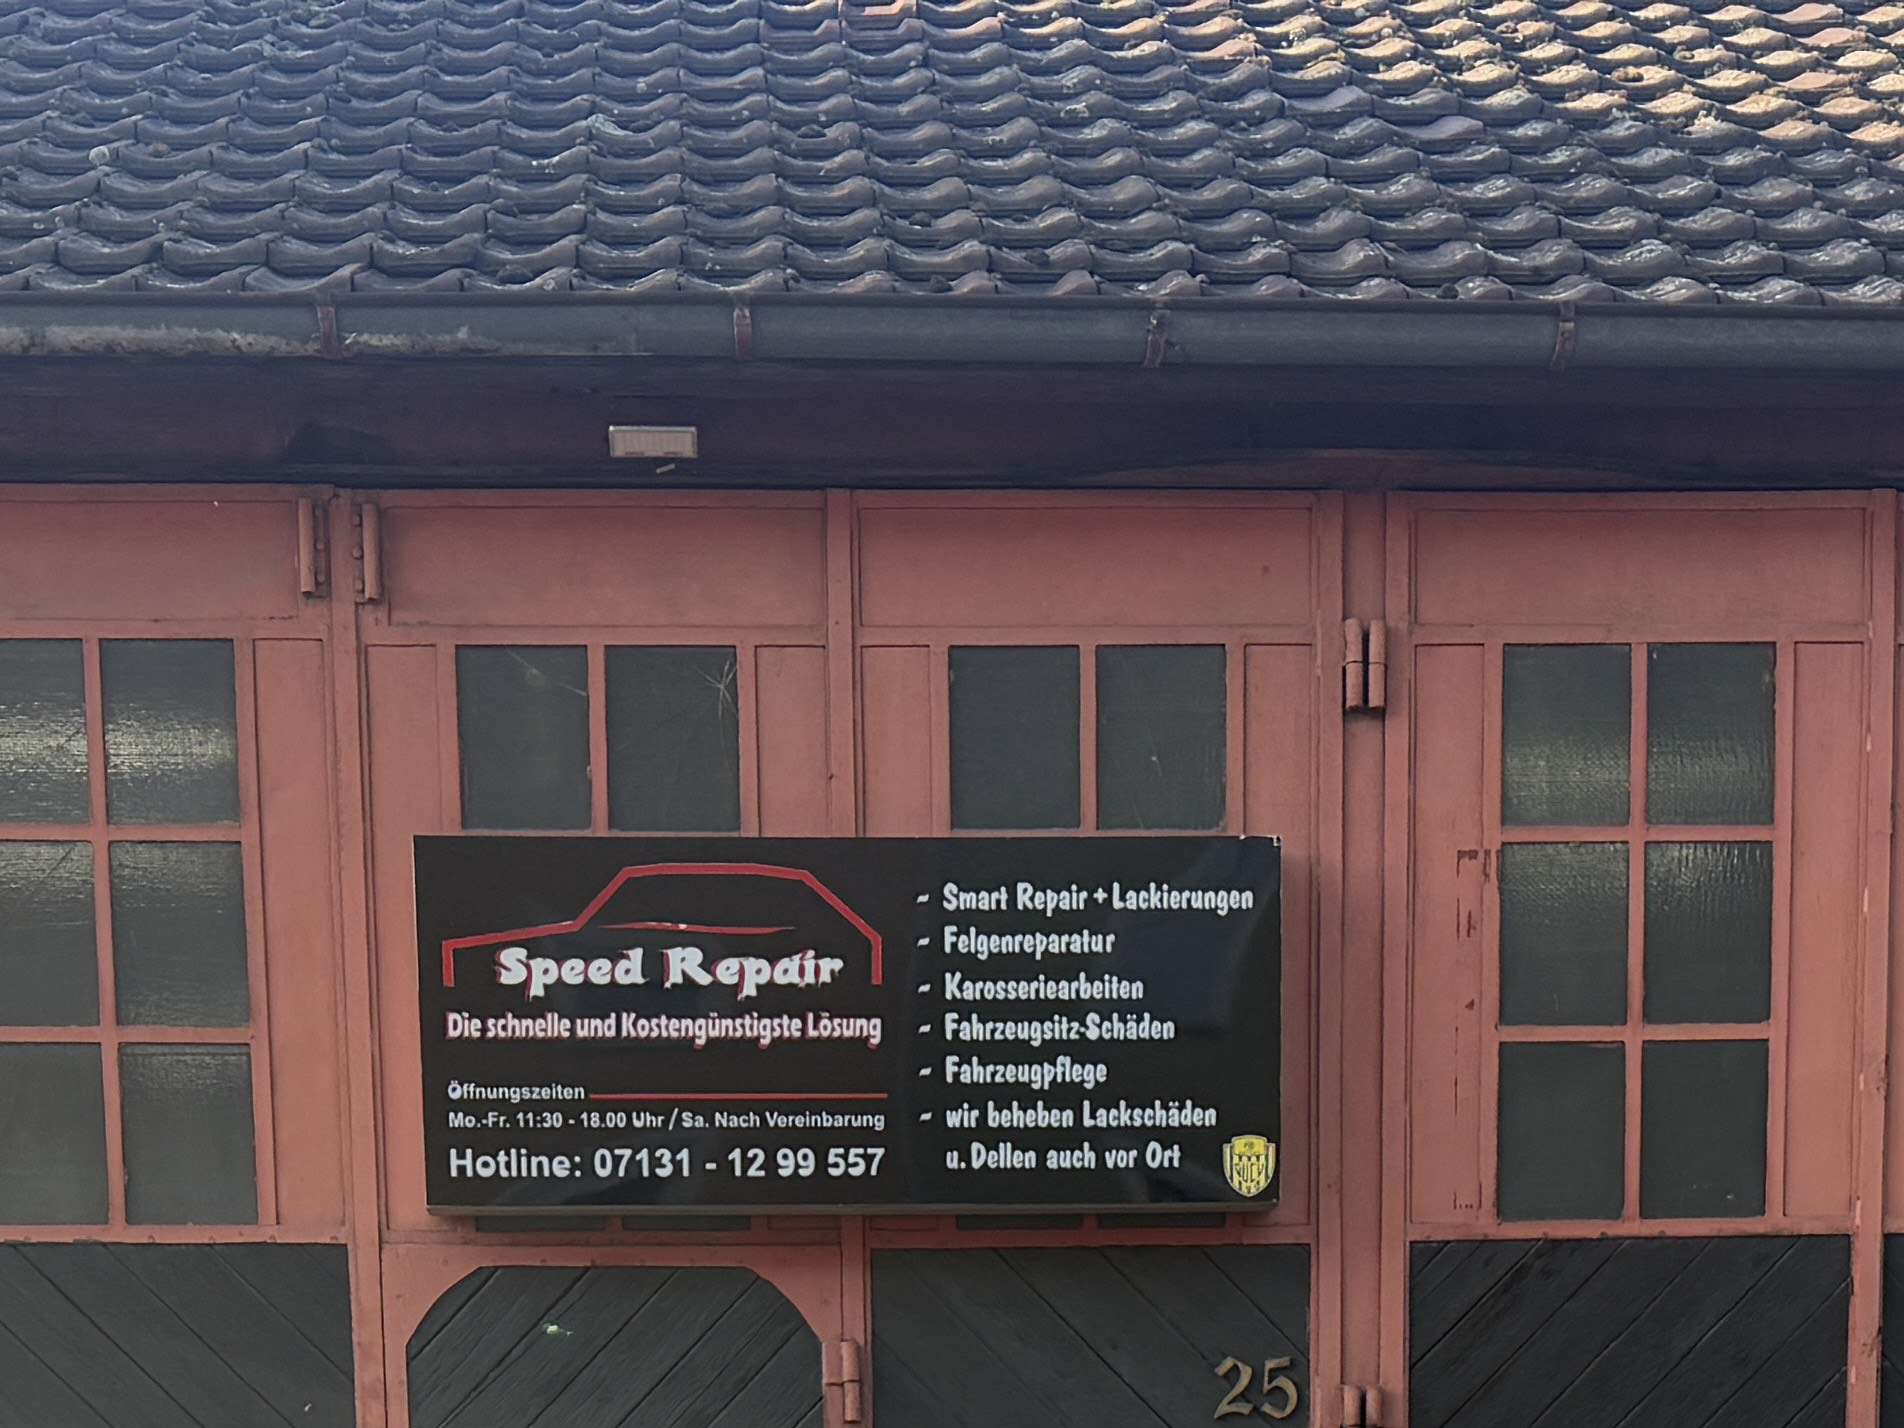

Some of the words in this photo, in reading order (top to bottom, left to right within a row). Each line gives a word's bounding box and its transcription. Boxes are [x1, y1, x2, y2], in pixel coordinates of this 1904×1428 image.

[943, 882, 1008, 911] Smart
[1016, 882, 1088, 917] Repair
[1112, 882, 1253, 916] Lackierungen
[944, 925, 1115, 960] Felgenreparatur
[495, 946, 650, 1001] Speed
[661, 946, 844, 1001] Repair
[945, 971, 1144, 1000] Karosseriearbeiten
[446, 1011, 482, 1039] Die
[487, 1011, 571, 1039] schnelle
[576, 1011, 617, 1039] und
[621, 1011, 802, 1049] Kostengünstigste
[806, 1011, 882, 1049] Lösung
[945, 1012, 1175, 1047] Fahrzeugsitz-Schäden
[945, 1055, 1108, 1090] Fahrzeugpflege
[447, 1080, 585, 1104] Öffnungszeiten
[448, 1111, 511, 1129] Mo.-Fr.
[516, 1111, 563, 1129] 11:30
[580, 1111, 627, 1129] 18.00
[632, 1111, 665, 1129] Uhr
[681, 1111, 710, 1129] Sa.
[714, 1111, 761, 1129] Nach
[765, 1111, 886, 1131] Vereinbarung
[946, 1102, 979, 1128] wir
[987, 1100, 1074, 1128] beheben
[1082, 1100, 1217, 1128] Lackschäden
[449, 1148, 582, 1178] Hotline:
[593, 1148, 690, 1178] 07131
[728, 1148, 766, 1178] 12
[776, 1148, 816, 1178] 99
[827, 1148, 886, 1178] 557
[970, 1142, 1037, 1169] Dellen
[1045, 1142, 1096, 1169] auch
[1104, 1149, 1138, 1169] vor
[1146, 1142, 1181, 1169] Ort
[1213, 1355, 1298, 1420] 25
